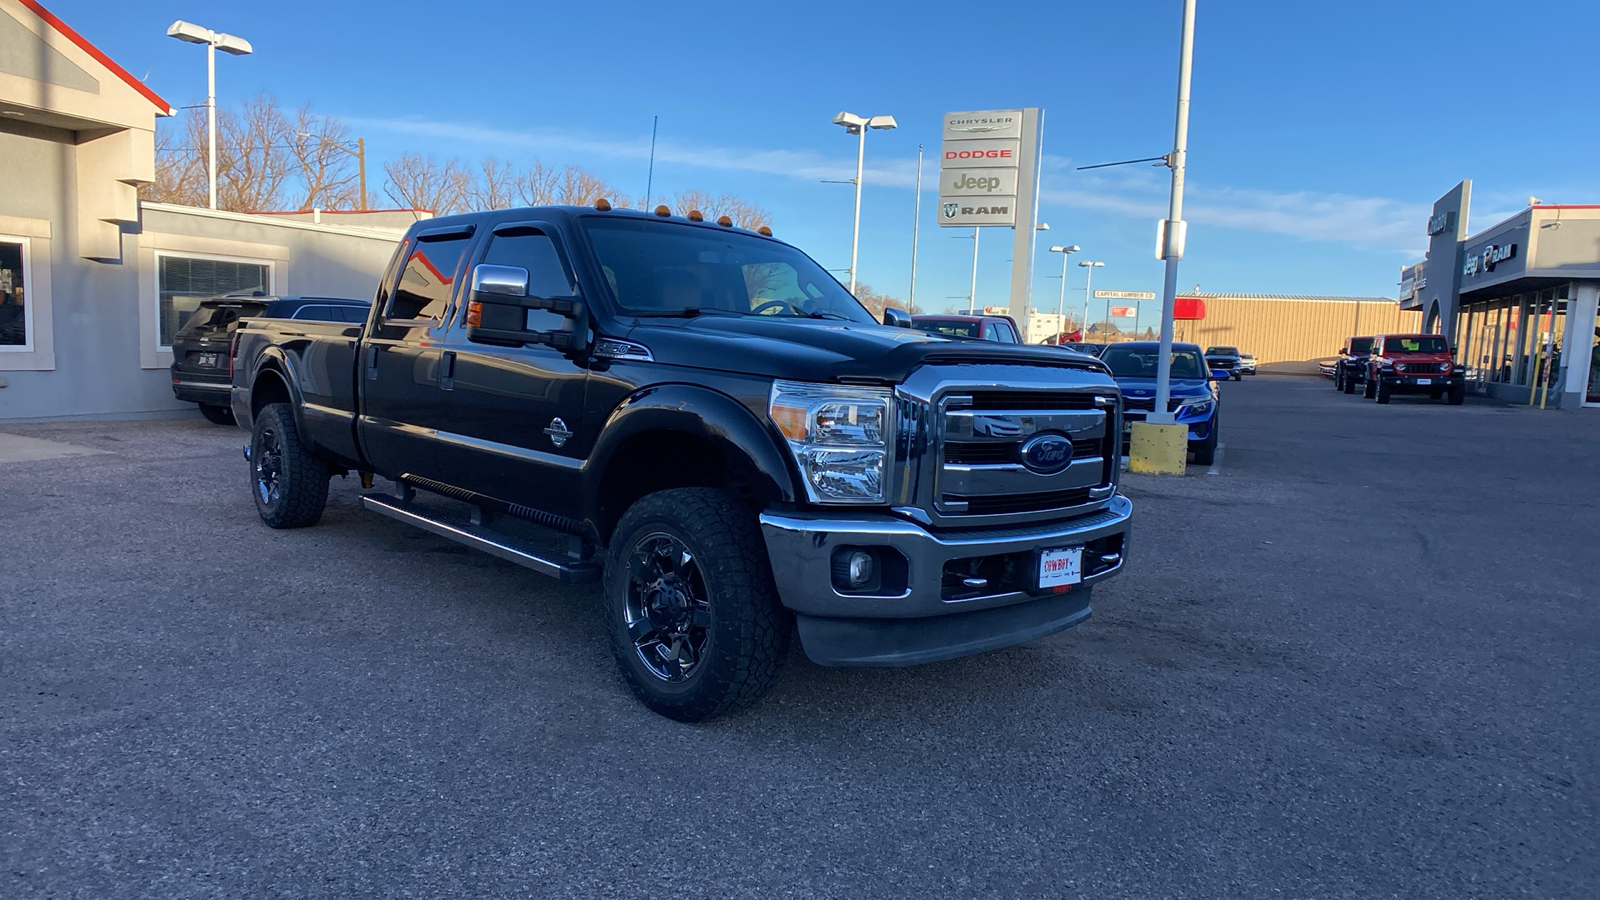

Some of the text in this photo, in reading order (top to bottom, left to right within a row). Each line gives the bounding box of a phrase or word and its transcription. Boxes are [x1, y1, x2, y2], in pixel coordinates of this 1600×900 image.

[949, 117, 1013, 126] CHRYSLER
[945, 149, 1012, 159] DODGE
[953, 173, 1001, 192] Jeep
[961, 206, 1009, 215] RAM
[1491, 244, 1513, 264] RAM
[1463, 253, 1479, 277] Jeep
[1037, 440, 1067, 461] Ford
[1044, 557, 1070, 573] COWBOY
